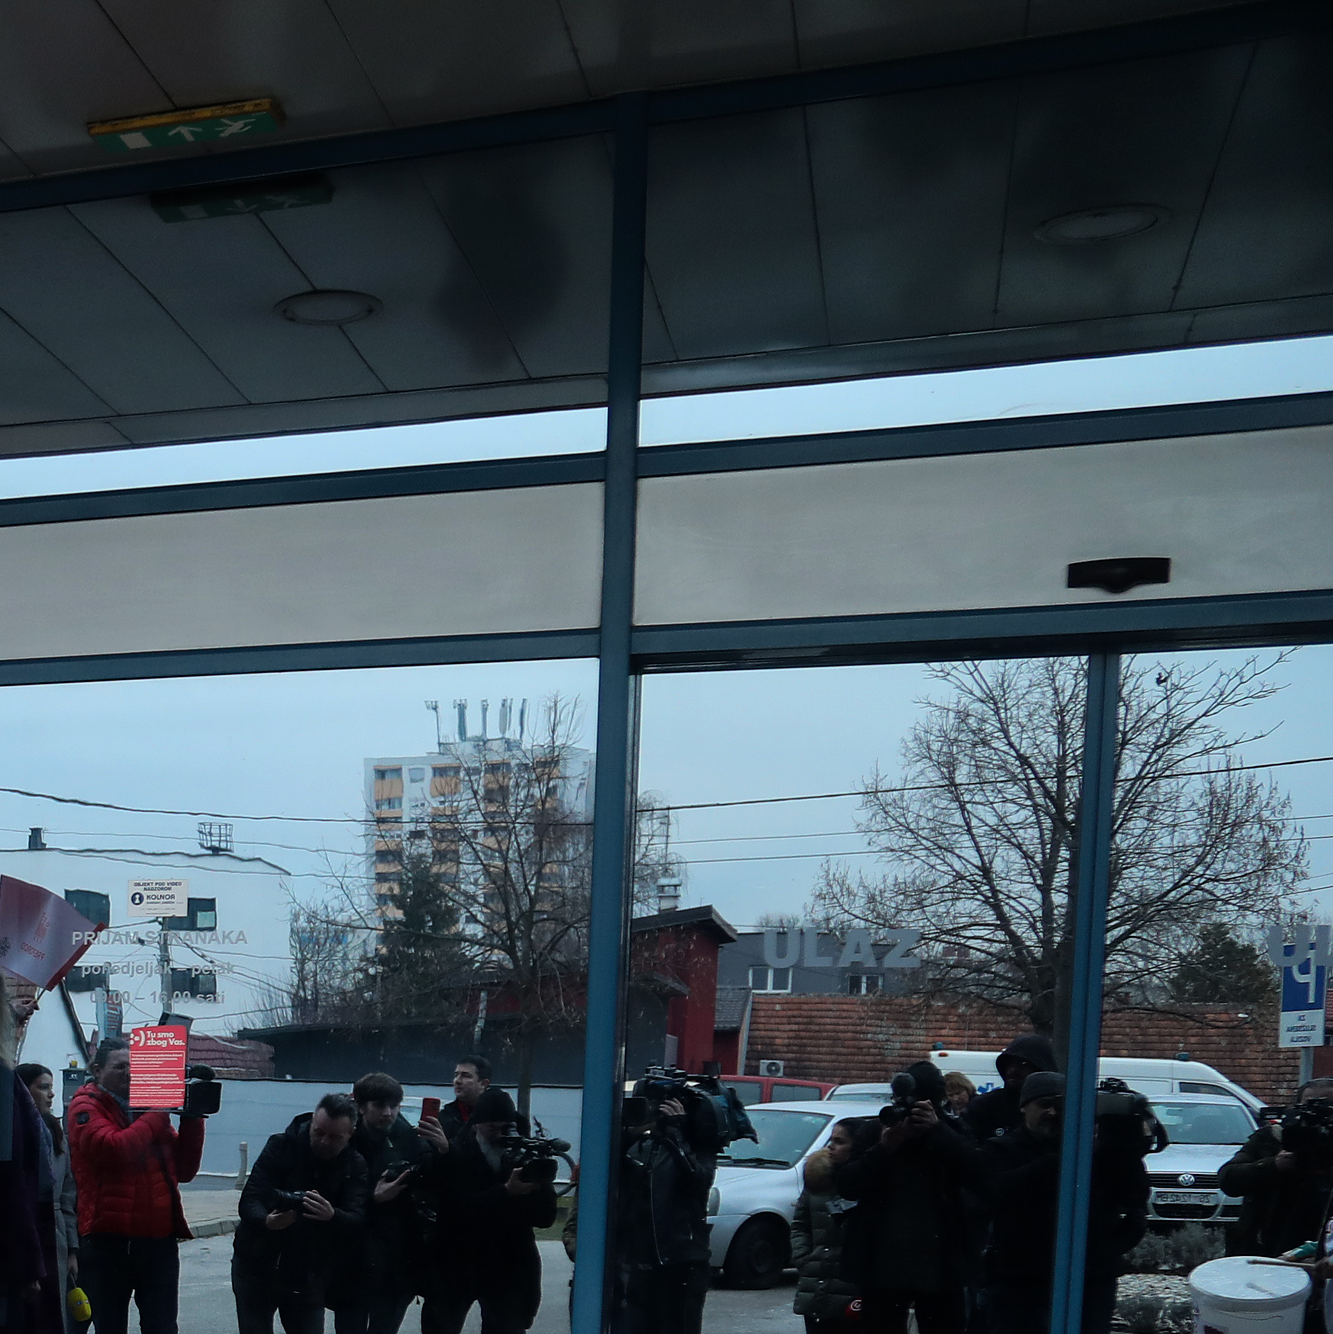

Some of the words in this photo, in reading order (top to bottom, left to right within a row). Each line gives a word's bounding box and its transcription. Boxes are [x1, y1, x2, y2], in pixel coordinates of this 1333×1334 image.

[72, 931, 139, 946] PRIJAM
[145, 930, 248, 945] STRANAKA
[1267, 924, 1333, 966] UL
[763, 928, 921, 968] ULAZ
[81, 961, 172, 977] ponedjeljak
[191, 962, 234, 977] petak
[196, 991, 225, 1004] sati
[147, 1039, 167, 1047] zbog
